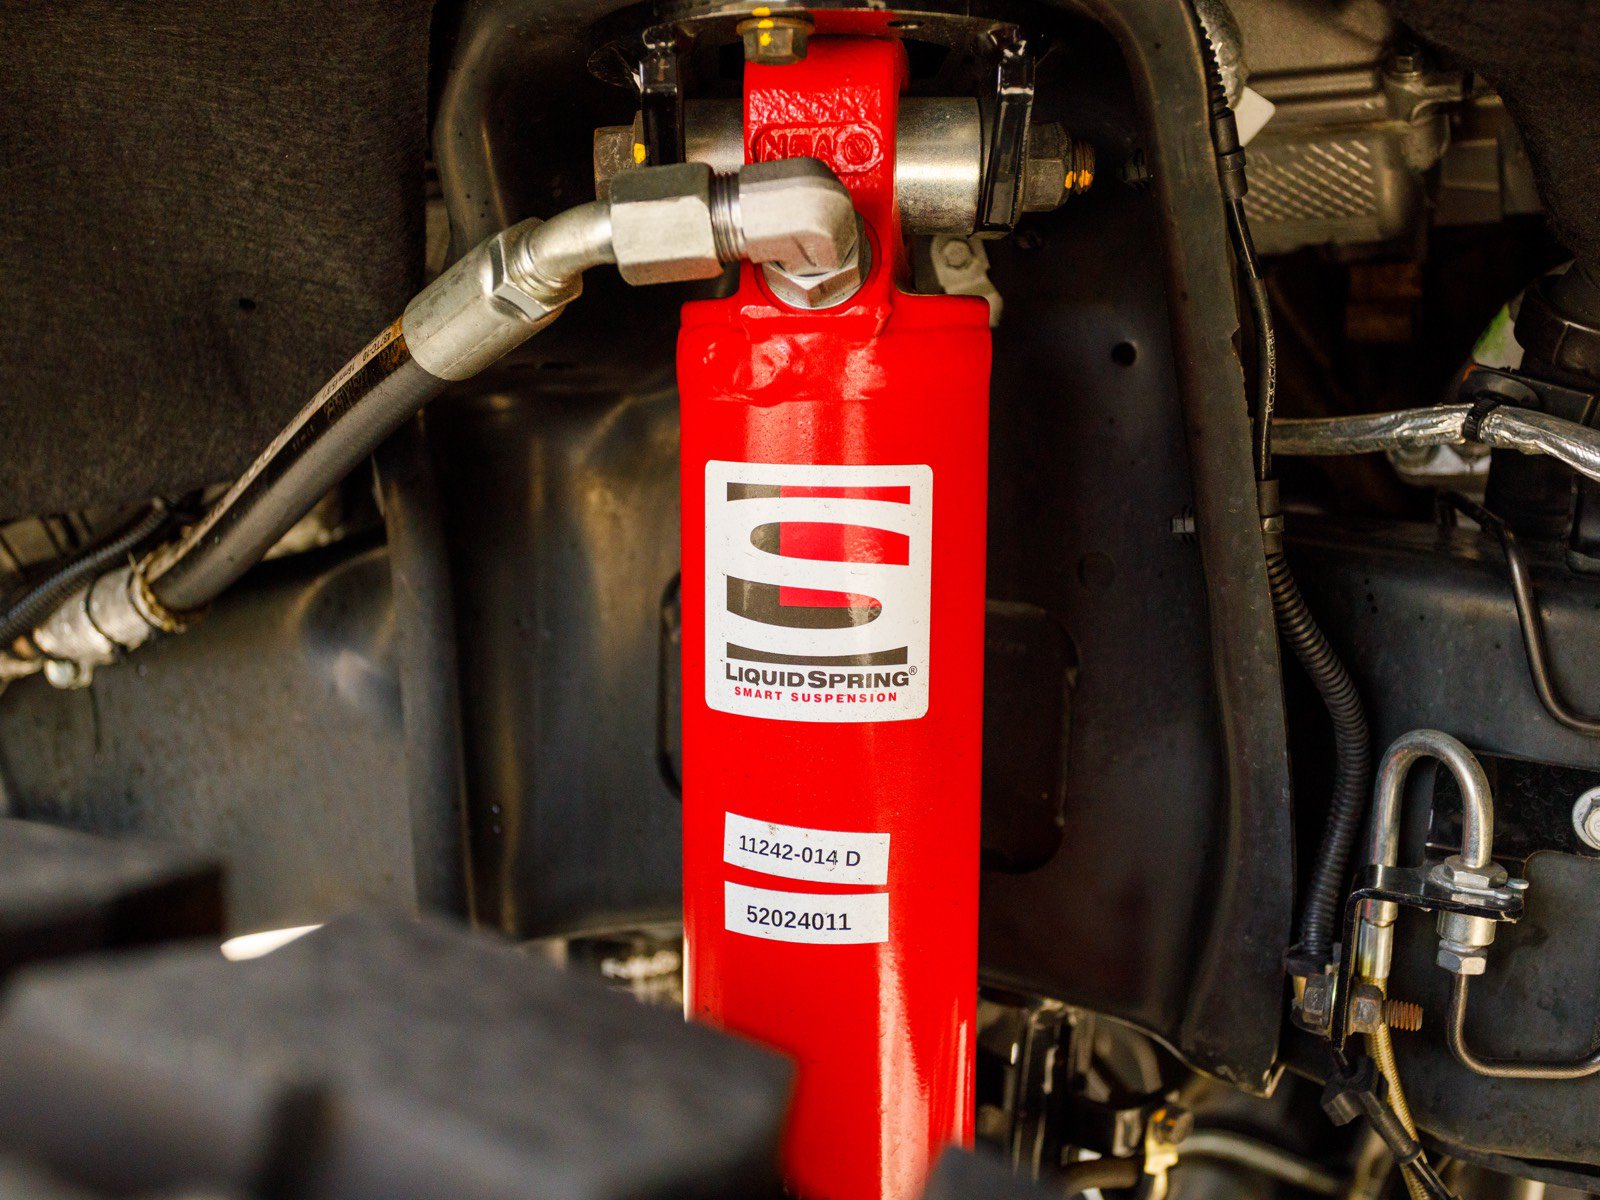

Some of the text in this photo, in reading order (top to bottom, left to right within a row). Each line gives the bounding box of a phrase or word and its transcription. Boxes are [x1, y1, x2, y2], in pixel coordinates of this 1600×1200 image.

[735, 686, 897, 703] SMART SUSPENSION
[739, 835, 861, 867] 11242-014 D
[747, 905, 852, 931] 52024011
